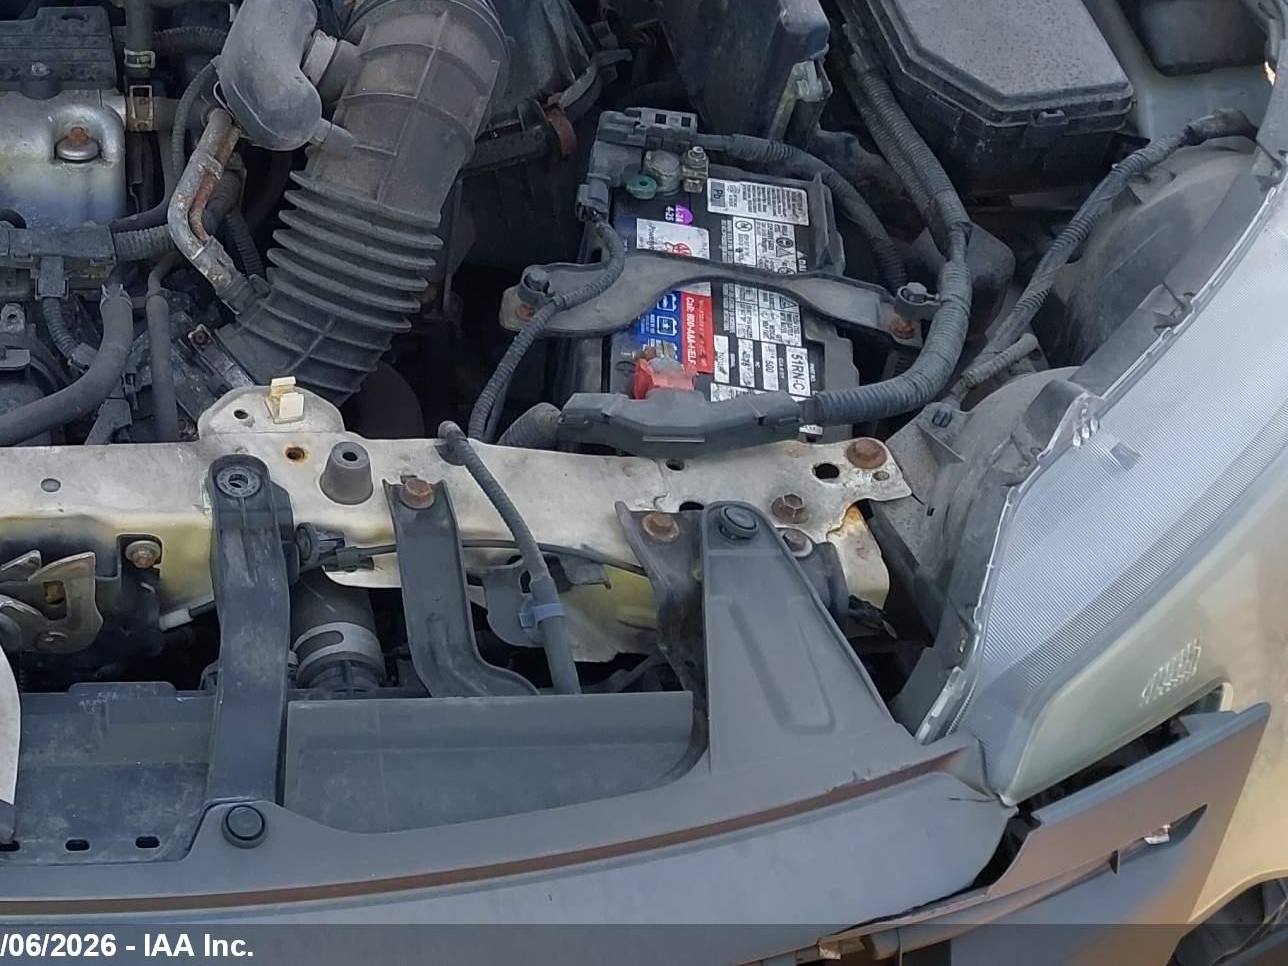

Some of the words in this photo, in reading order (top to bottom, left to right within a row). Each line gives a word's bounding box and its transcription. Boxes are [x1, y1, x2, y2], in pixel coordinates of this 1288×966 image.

[712, 188, 724, 201] Pb
[765, 360, 775, 374] 500
[790, 353, 806, 391] 51RN-C
